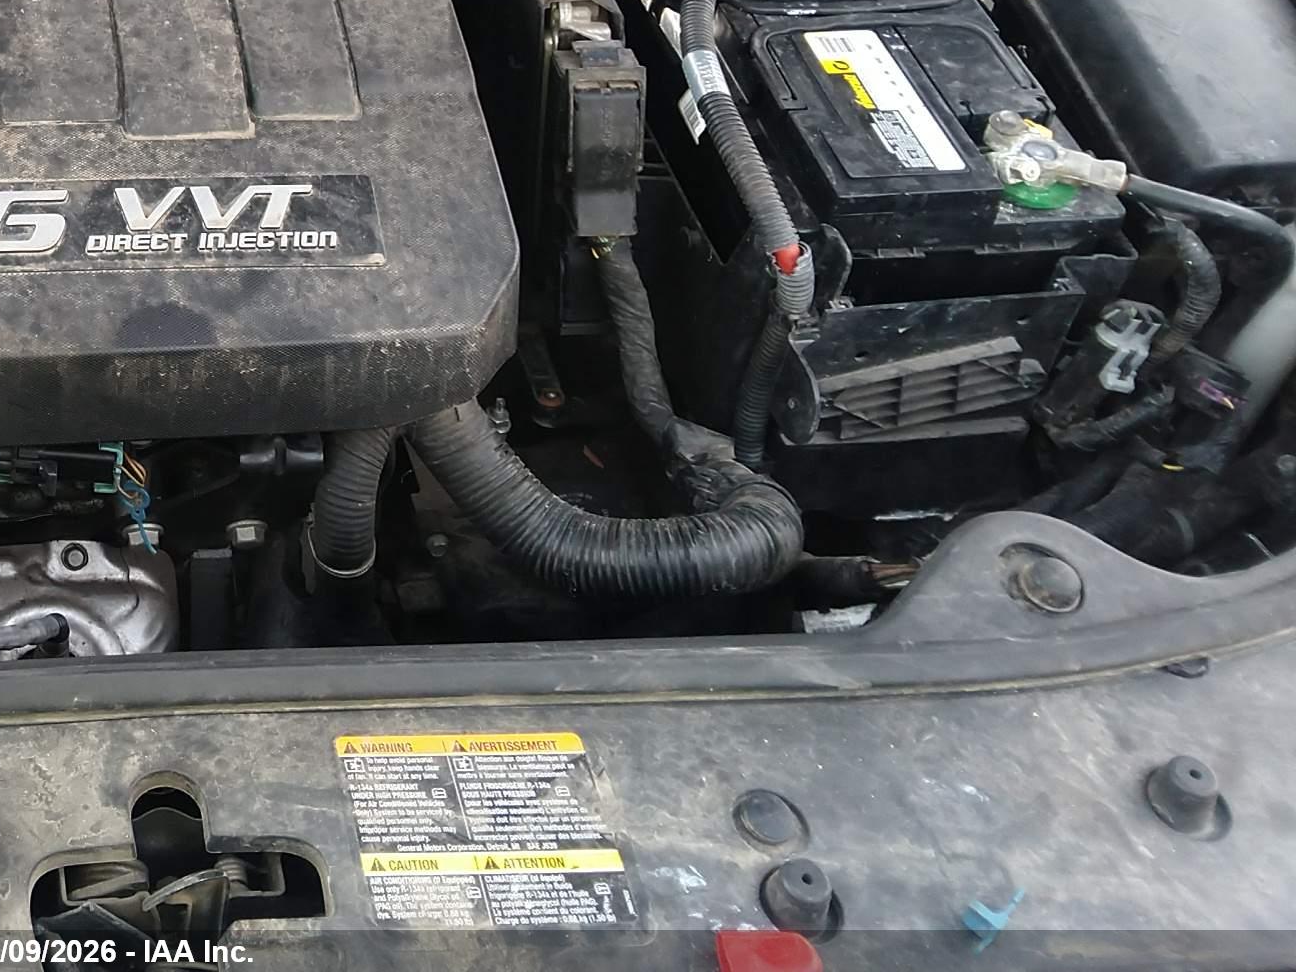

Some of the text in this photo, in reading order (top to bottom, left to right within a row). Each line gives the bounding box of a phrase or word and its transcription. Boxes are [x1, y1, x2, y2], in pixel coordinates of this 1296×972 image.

[112, 185, 312, 231] VVT
[85, 229, 338, 255] DIRECT INJECTION
[360, 742, 414, 753] WARNING
[470, 740, 557, 752] AVERTISSEMENT
[351, 791, 374, 799] UNDER
[375, 791, 391, 799] HIGH
[398, 843, 422, 851] General
[423, 843, 446, 851] Motors
[388, 859, 439, 871] CAUTION
[504, 857, 565, 869] ATTENTION
